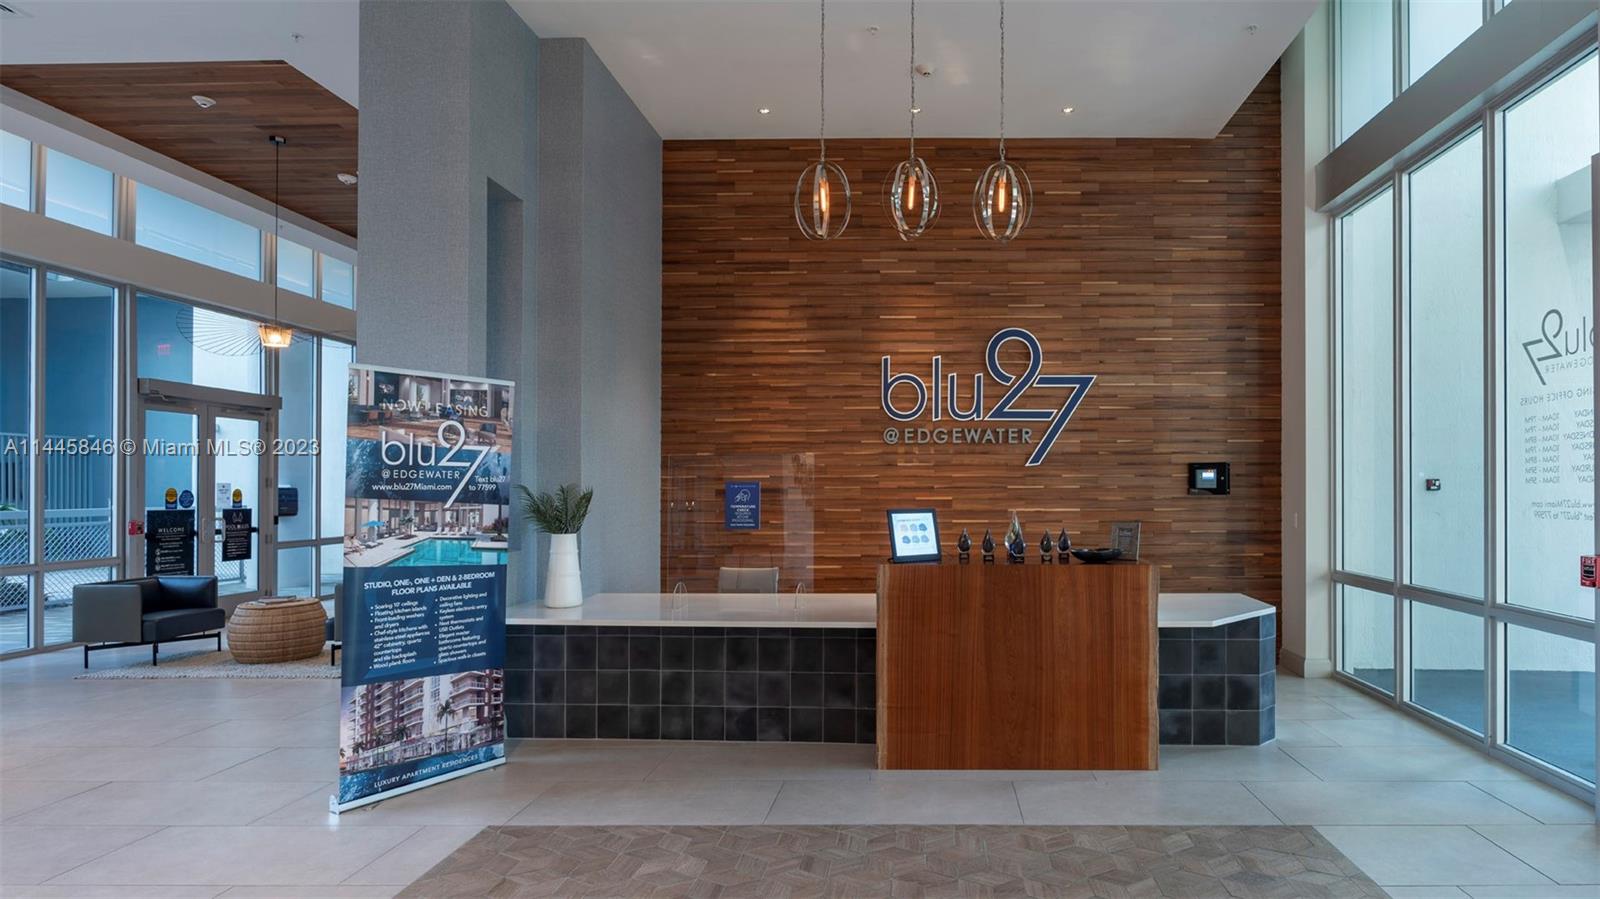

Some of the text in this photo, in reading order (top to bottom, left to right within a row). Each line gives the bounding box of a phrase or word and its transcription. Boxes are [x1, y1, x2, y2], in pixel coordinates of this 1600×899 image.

[881, 327, 1098, 467] blu27
[383, 398, 421, 412] NOW
[381, 420, 493, 508] blu27
[371, 482, 452, 491] www.blu27Miami.com
[474, 475, 506, 483] Text blu27
[477, 483, 497, 491] 77599
[364, 581, 392, 590] STUDIO,
[414, 577, 430, 585] ONE
[436, 575, 451, 583] DEN
[458, 571, 495, 581] 2-BEDROOM
[391, 581, 472, 596] FLOOR PLANS AVAILABLE
[373, 754, 479, 788] LUXURY APARTMENT RESIDENCES
